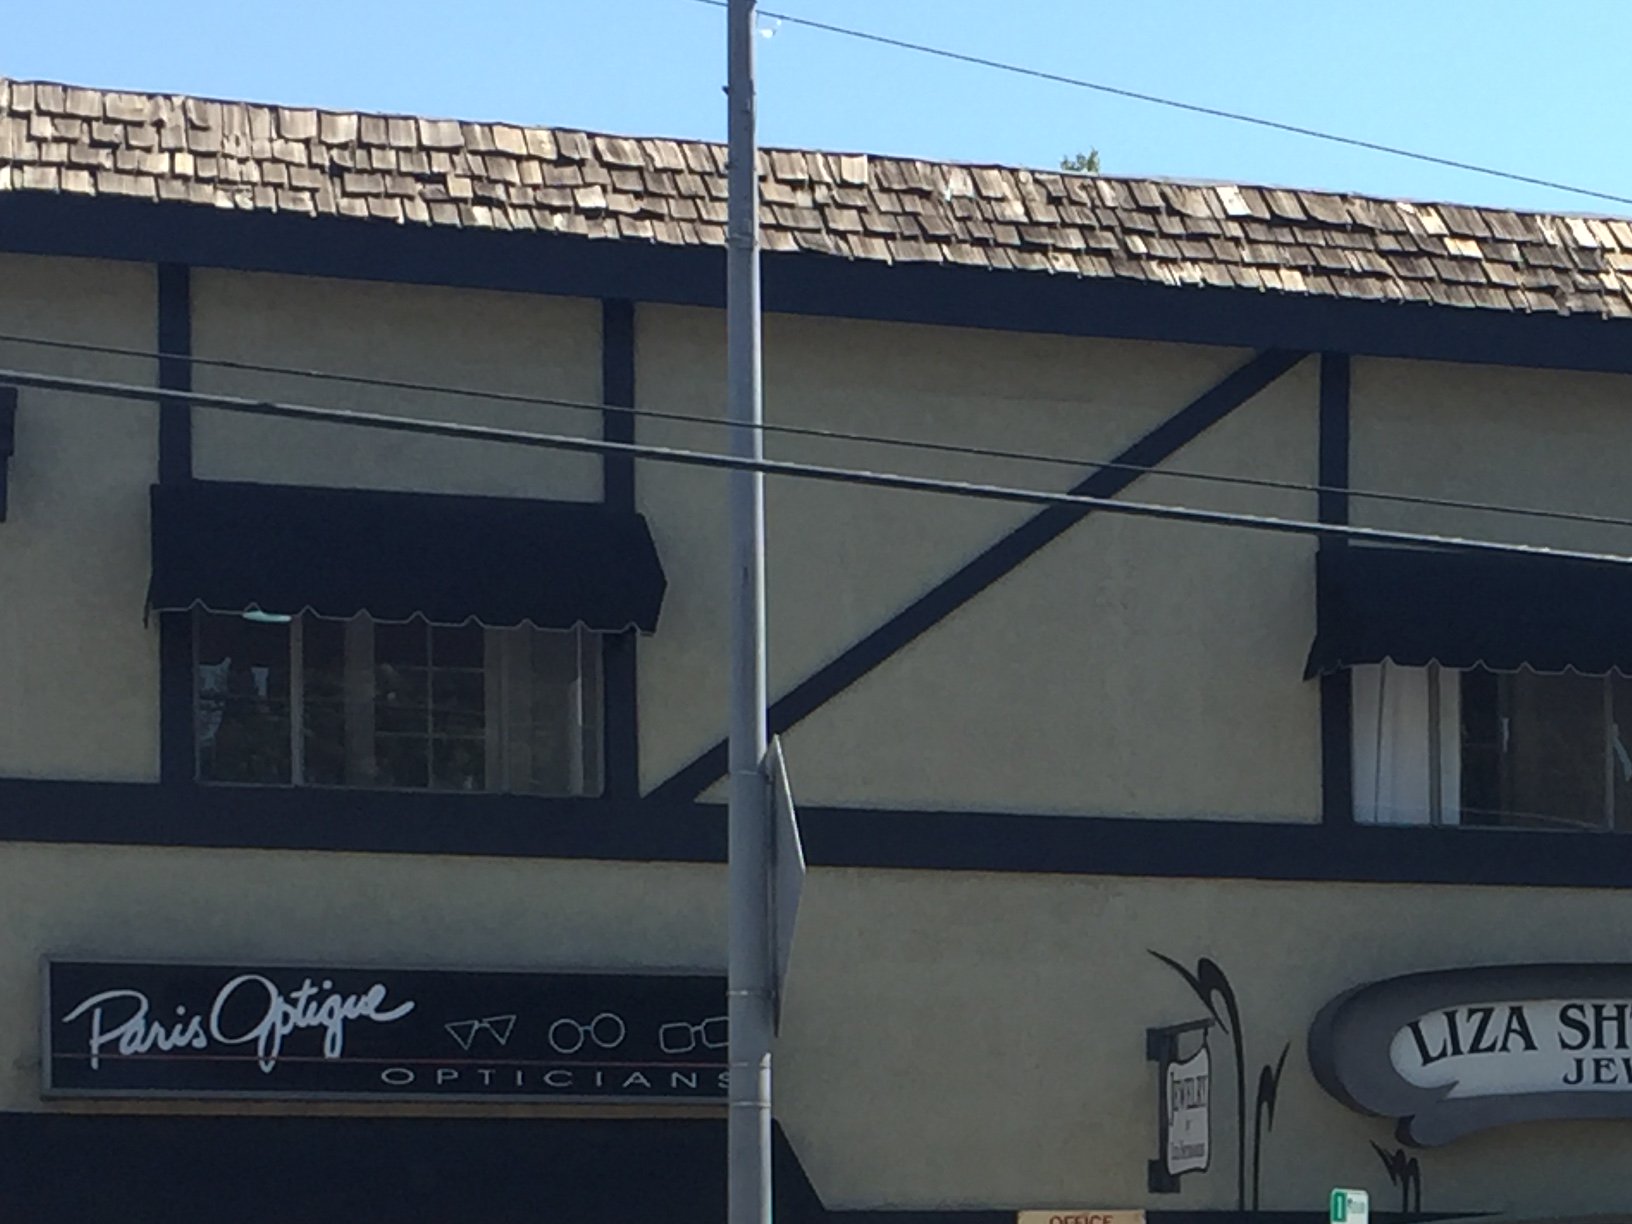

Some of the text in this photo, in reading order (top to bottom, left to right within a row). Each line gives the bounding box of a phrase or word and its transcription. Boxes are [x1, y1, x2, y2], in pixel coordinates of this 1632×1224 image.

[62, 974, 415, 1073] Paris Optique
[1407, 1007, 1538, 1066] LIZA
